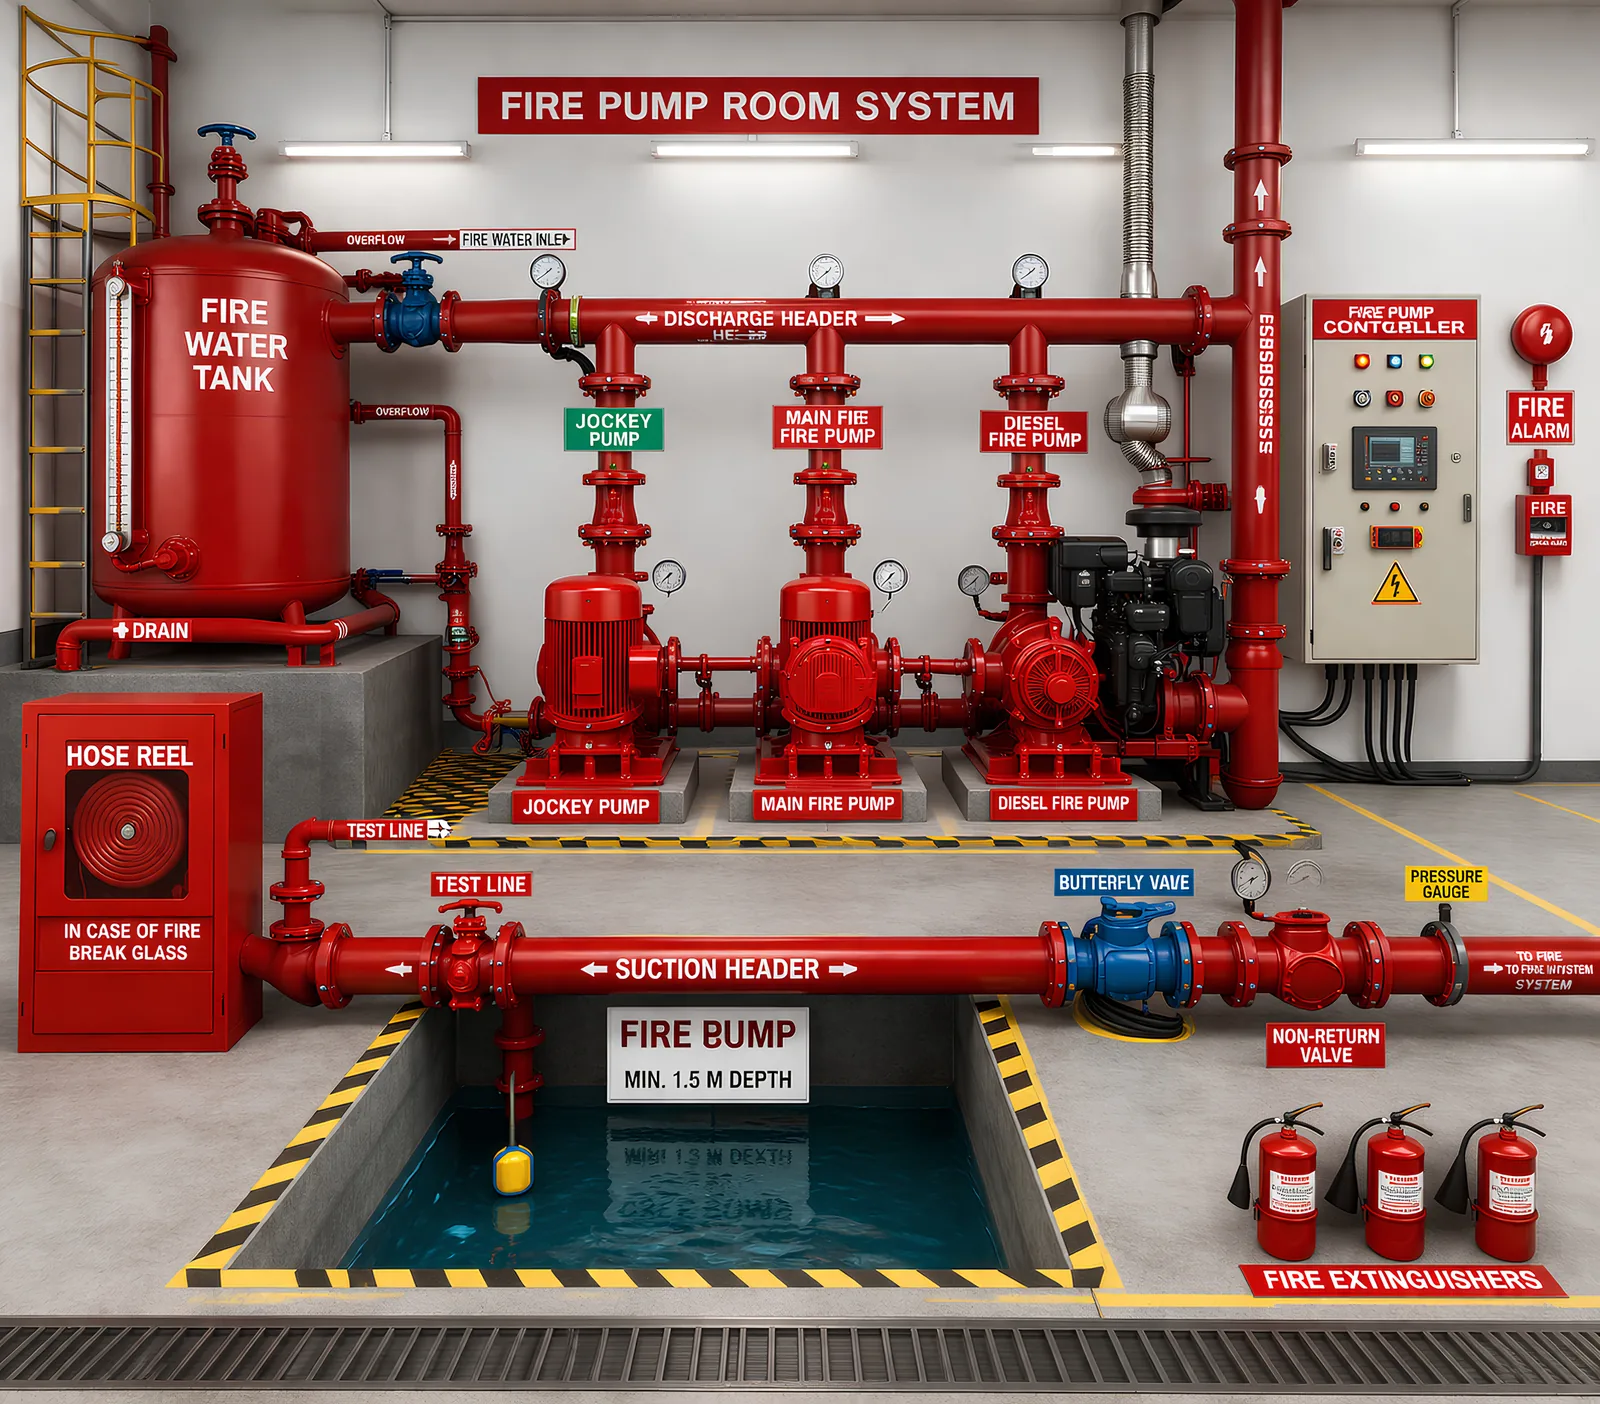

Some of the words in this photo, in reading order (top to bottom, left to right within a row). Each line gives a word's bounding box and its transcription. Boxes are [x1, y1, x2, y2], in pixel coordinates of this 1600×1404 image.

[501, 91, 583, 119] FIRE
[600, 91, 708, 119] PUMP
[723, 91, 839, 120] ROOM
[855, 91, 1014, 120] SYSTEM
[346, 235, 406, 245] OVERFLOW
[462, 233, 488, 246] FIRE
[492, 233, 532, 247] WATER
[201, 298, 268, 325] FIRE
[664, 310, 774, 327] DISCHARGE
[781, 310, 857, 326] HEADER
[1388, 306, 1434, 319] PUMP
[184, 331, 288, 360] WATER
[192, 365, 274, 392] TANK
[375, 407, 430, 416] OVERFLOW
[1518, 397, 1564, 418] FIRE
[575, 413, 652, 429] JOCKEY
[786, 410, 831, 425] MAIN
[1004, 416, 1065, 431] DIESEL
[589, 431, 640, 446] PUMP
[780, 428, 819, 443] FIRE
[825, 428, 875, 443] PUMP
[1511, 423, 1570, 439] ALARM
[989, 432, 1026, 447] FIRE
[1032, 432, 1082, 447] PUMP
[1531, 502, 1566, 514] FIRE
[132, 622, 188, 639] DRAIN
[67, 745, 129, 766] HOSE
[137, 745, 194, 766] REEL
[523, 799, 593, 815] JOCKEY
[599, 799, 650, 815] PUMP
[761, 796, 802, 811] MAIN
[808, 796, 844, 811] FIRE
[848, 796, 895, 811] PUMP
[998, 796, 1047, 810] DIESEL
[1052, 796, 1083, 810] FIRE
[1088, 796, 1130, 810] PUMP
[347, 823, 385, 838] TEST
[390, 823, 424, 838] LINE
[436, 876, 481, 893] TEST
[487, 876, 526, 893] LINE
[1059, 874, 1144, 890] BUTTERFLY
[1411, 870, 1483, 883] PRESSURE
[1423, 885, 1470, 898] GAUGE
[64, 923, 81, 939] IN
[86, 923, 131, 939] CASE
[136, 923, 159, 939] OF
[164, 923, 201, 939] FIRE
[69, 945, 127, 961] BREAK
[132, 945, 188, 961] GLASS
[1516, 951, 1533, 962] TO
[1536, 951, 1563, 962] FIRE
[615, 958, 716, 980] SUCTION
[725, 958, 820, 980] HEADER
[1505, 964, 1519, 974] TO
[1515, 980, 1572, 990] SYSTEM
[620, 1020, 692, 1048] FIRE
[1273, 1028, 1380, 1044] NON-RETURN
[1300, 1047, 1353, 1063] VALVE
[625, 1070, 666, 1089] MIN.
[673, 1070, 700, 1089] 1.5
[706, 1070, 722, 1089] M
[729, 1070, 792, 1089] DEPTH
[1263, 1270, 1325, 1289] FIRE
[1330, 1270, 1543, 1290] EXTINGUISHERS
